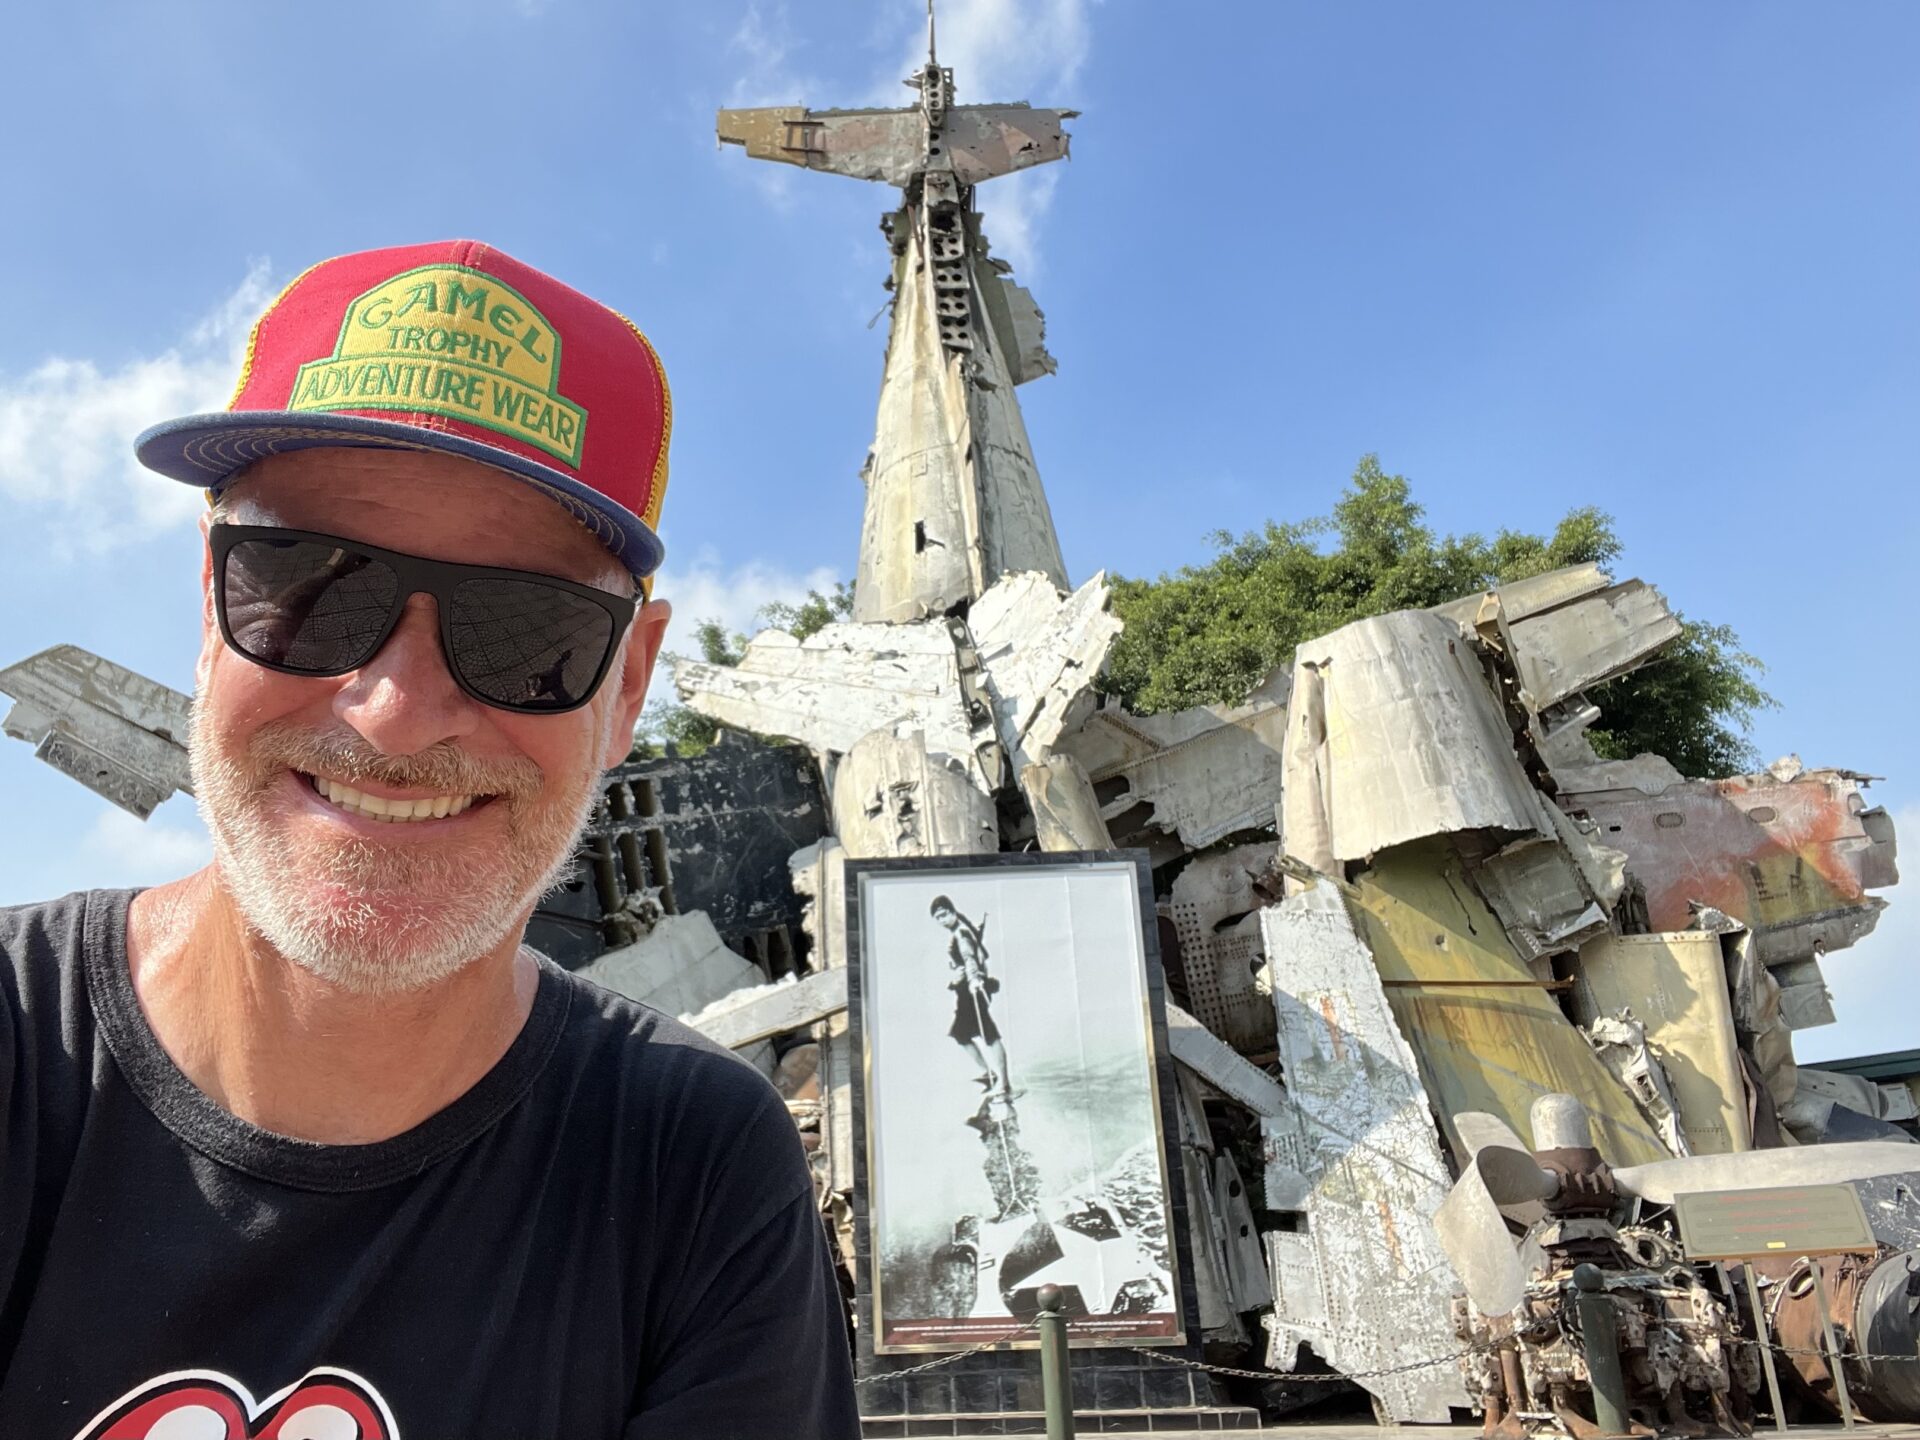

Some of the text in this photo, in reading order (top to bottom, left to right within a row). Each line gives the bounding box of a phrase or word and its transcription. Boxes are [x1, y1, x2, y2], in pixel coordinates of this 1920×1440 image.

[359, 280, 547, 363] CAMEL
[388, 325, 512, 368] TROPHY
[297, 363, 575, 449] ADVENTURE WEAR
